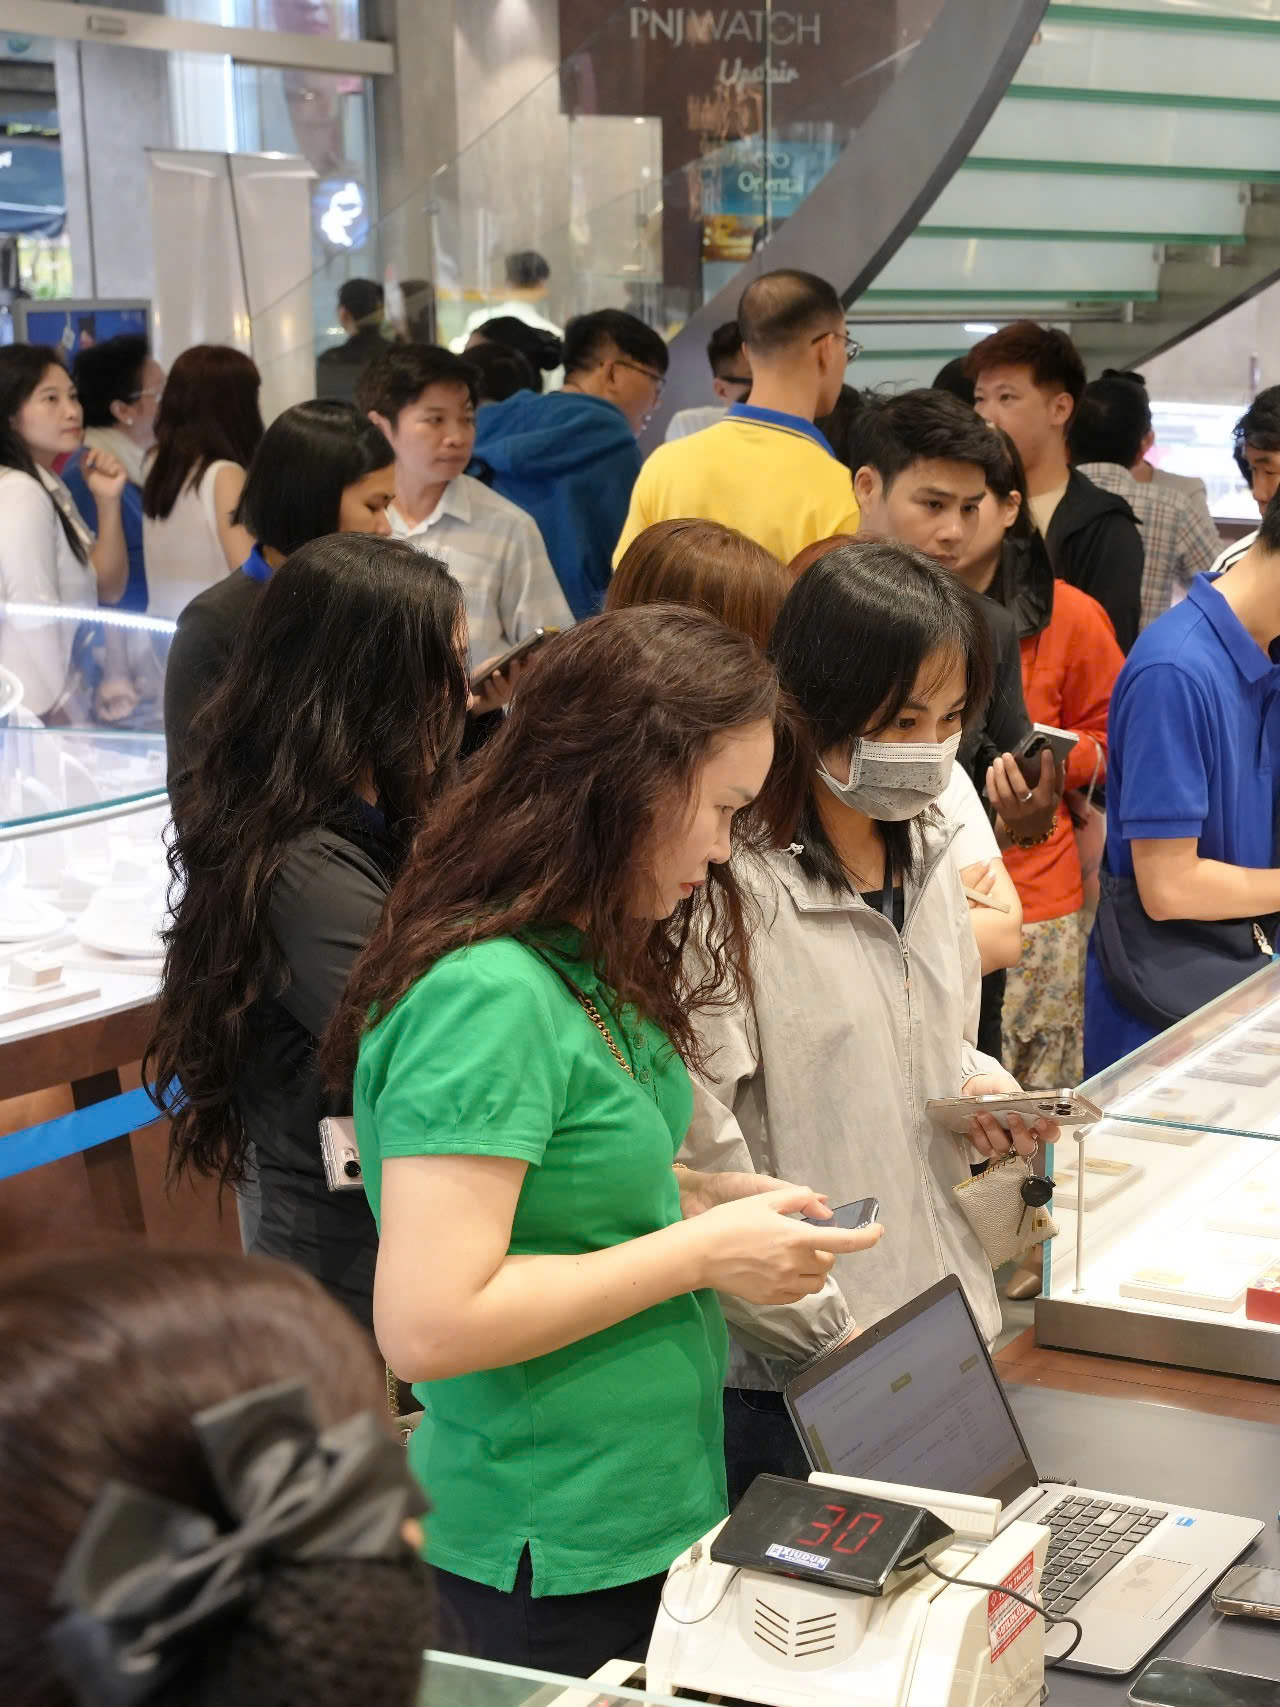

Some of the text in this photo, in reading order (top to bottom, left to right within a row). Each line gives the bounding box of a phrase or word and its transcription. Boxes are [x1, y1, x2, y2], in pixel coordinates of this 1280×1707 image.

[629, 7, 821, 47] PNJ WATCH
[797, 1504, 885, 1555] 30
